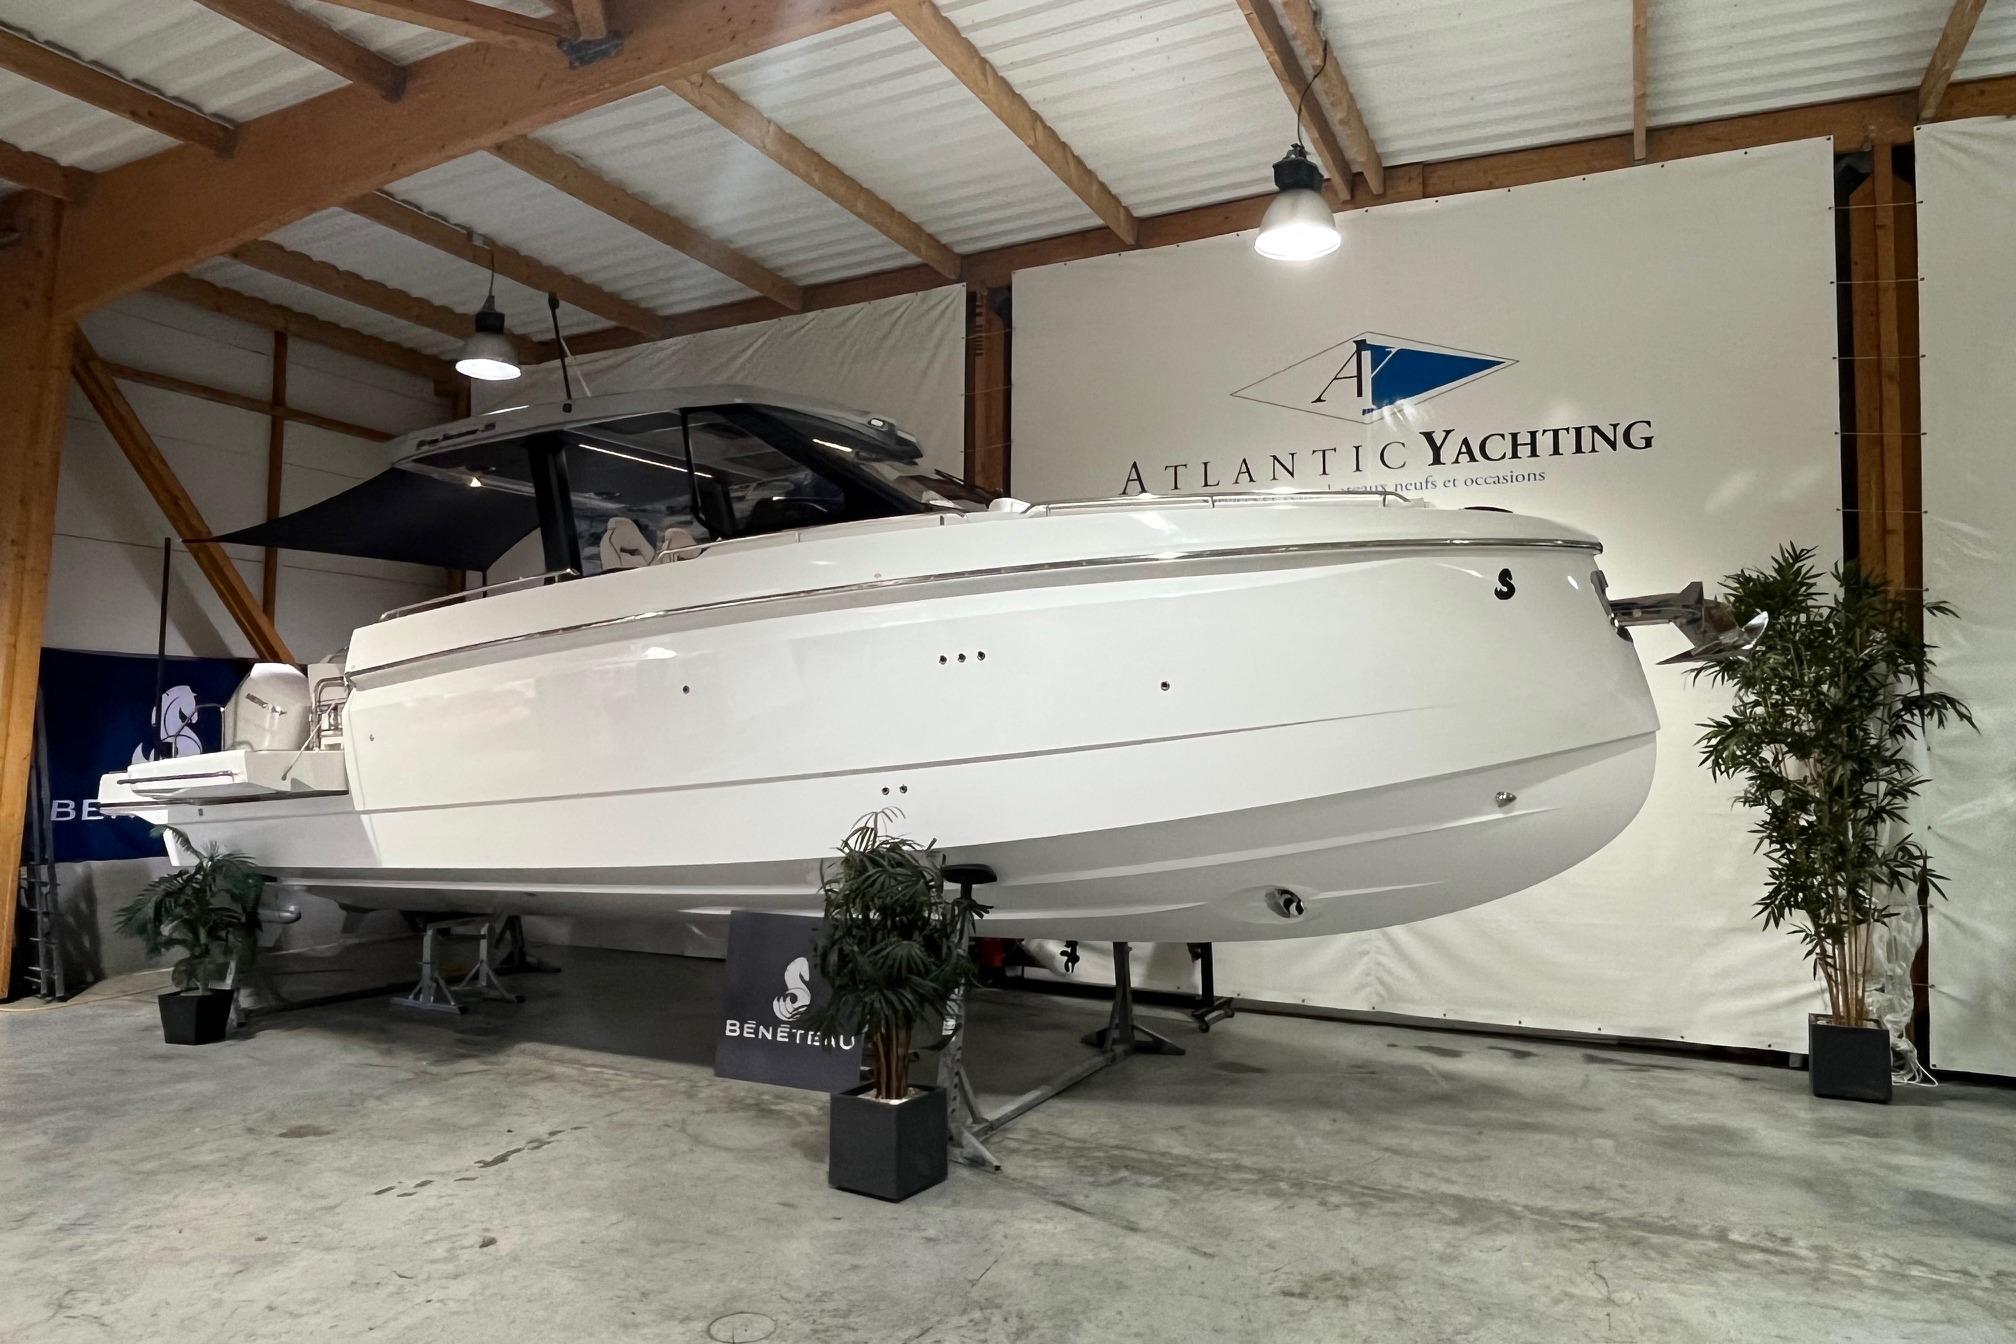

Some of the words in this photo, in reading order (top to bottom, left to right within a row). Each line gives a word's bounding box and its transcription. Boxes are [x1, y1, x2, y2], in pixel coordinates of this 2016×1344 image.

[1118, 441, 1407, 496] ATLANTIC
[1419, 420, 1655, 467] YACHTING
[1394, 475, 1438, 492] neufs
[1442, 476, 1458, 488] et
[1463, 470, 1546, 487] occasions
